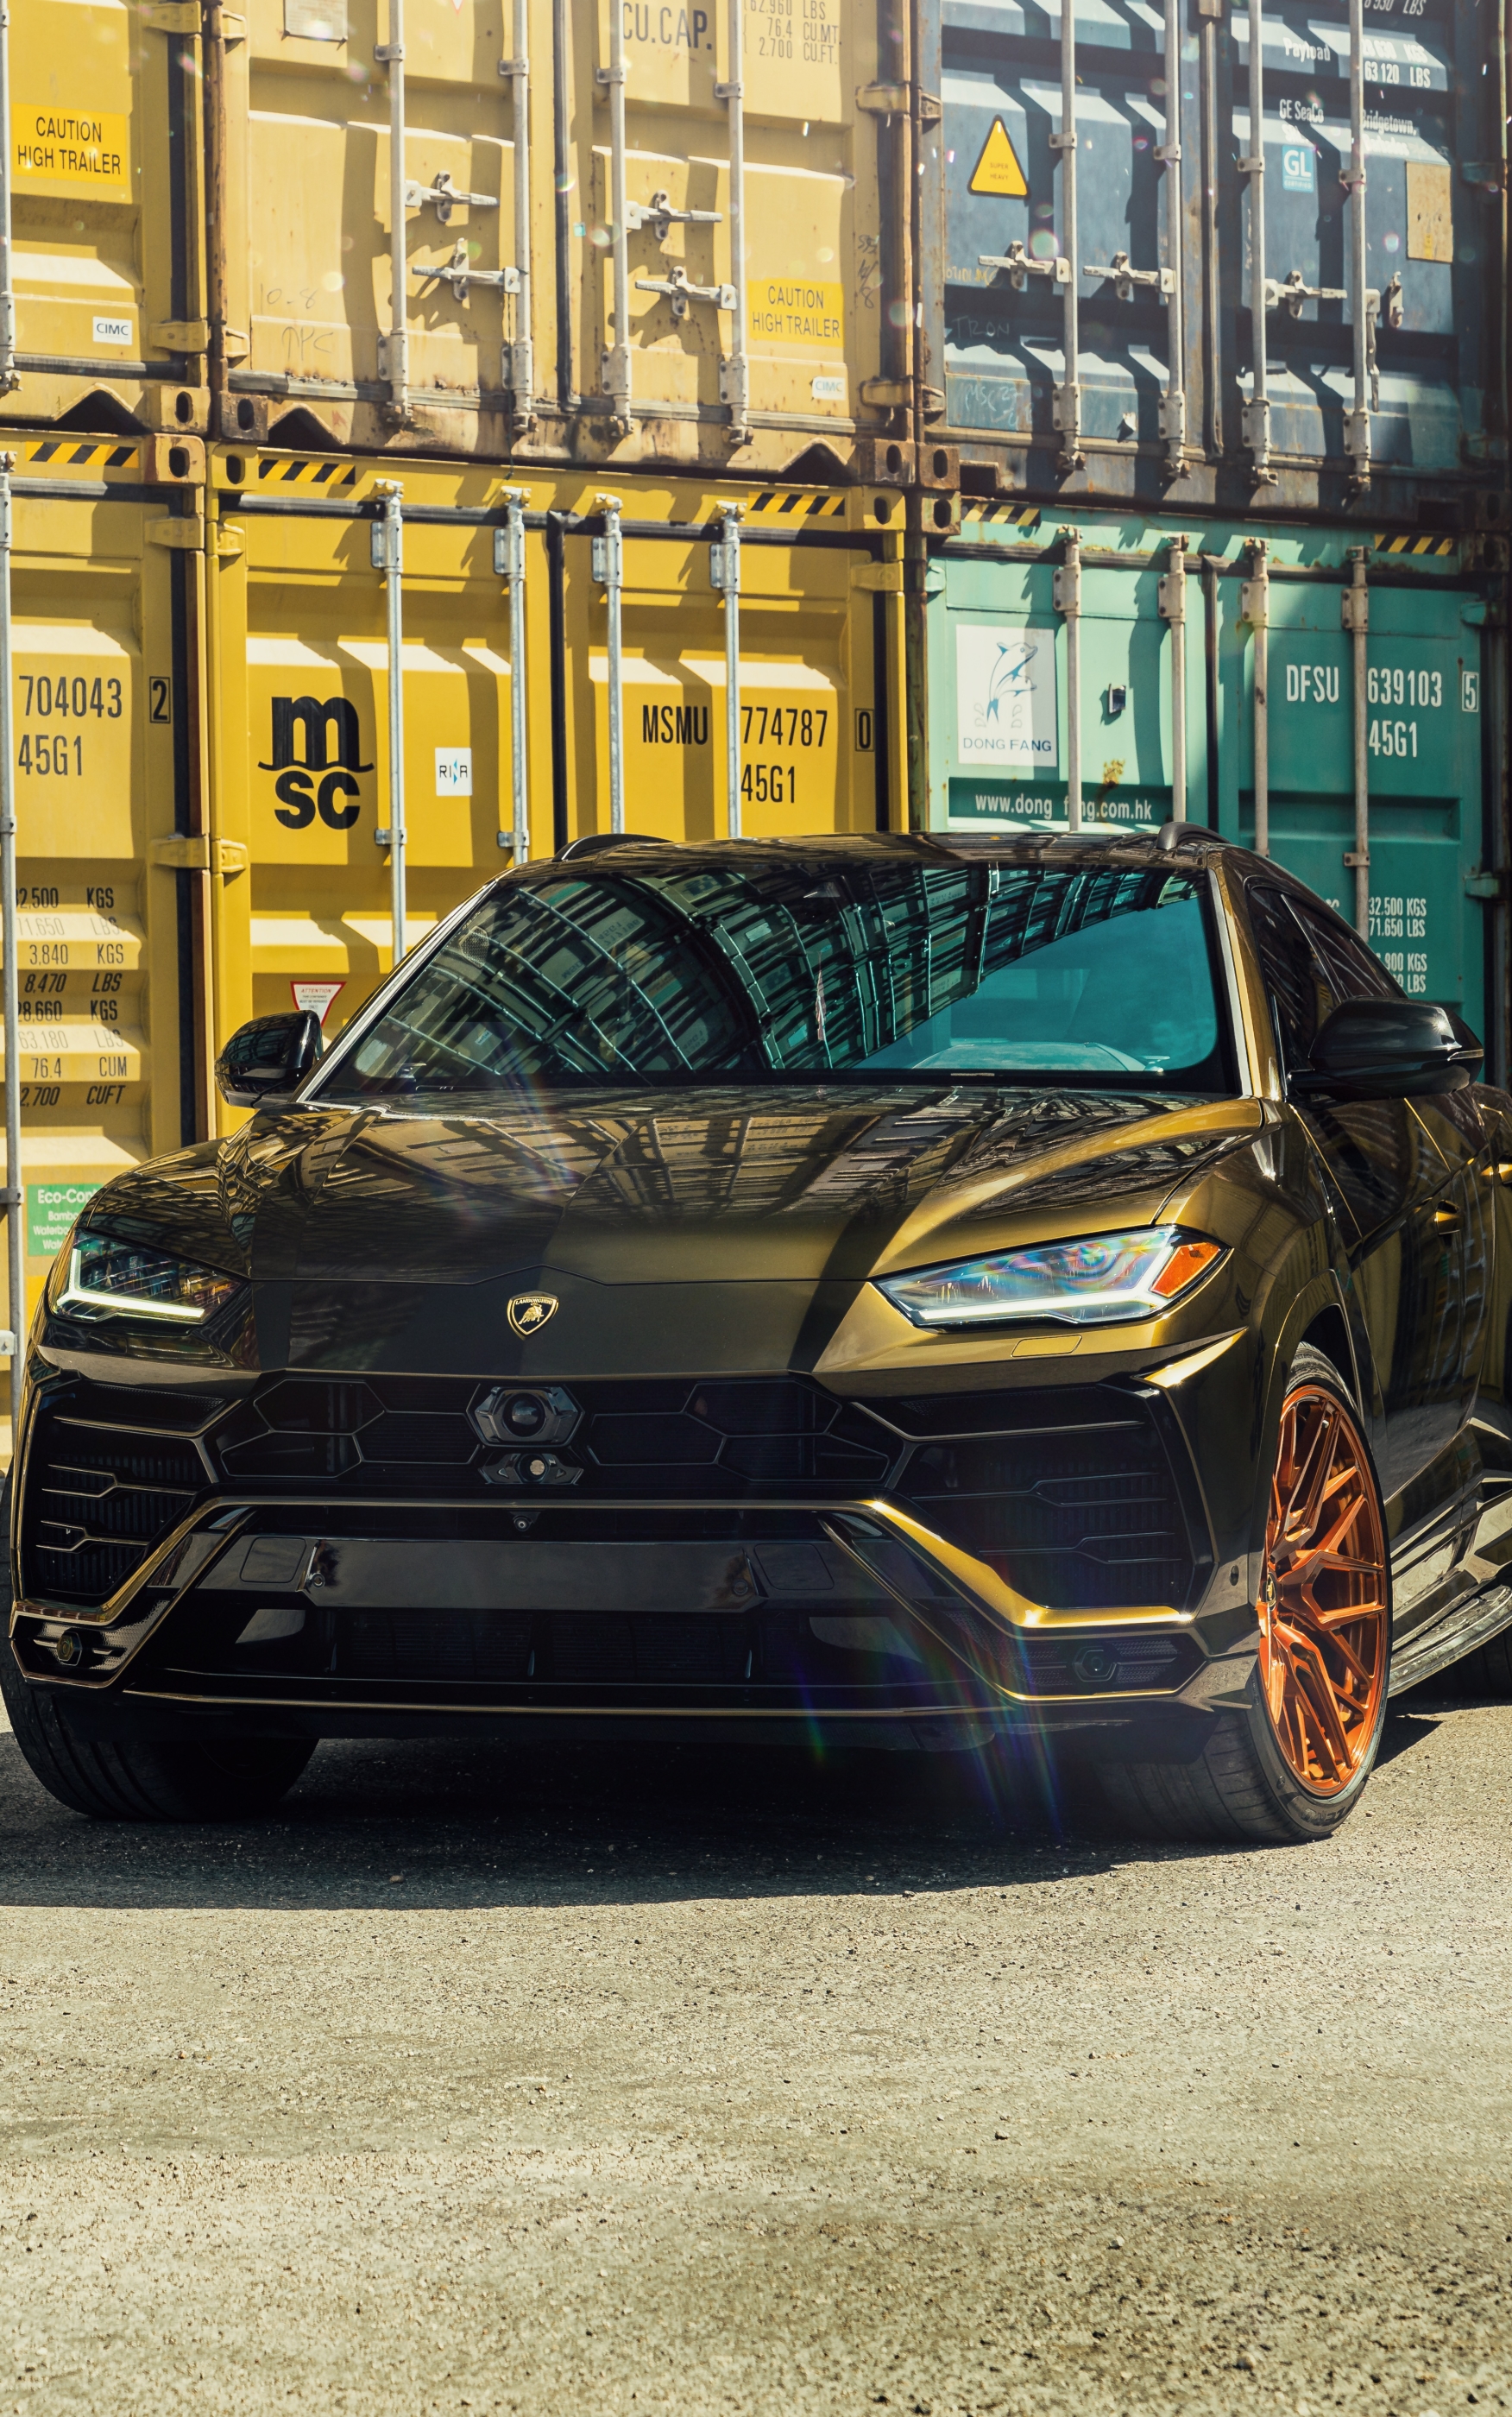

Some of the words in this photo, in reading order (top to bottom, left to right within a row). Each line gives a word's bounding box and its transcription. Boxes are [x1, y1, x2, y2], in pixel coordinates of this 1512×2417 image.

[803, 0, 826, 20] LBS
[1402, 0, 1427, 16] LBS
[622, 3, 712, 50] CU.CAP.
[767, 16, 792, 38] 76.4
[759, 36, 792, 59] 2.700
[1282, 37, 1331, 62] Payload
[1403, 43, 1428, 63] KGS
[1409, 66, 1430, 88] LBS
[1279, 99, 1293, 119] GE
[1295, 101, 1325, 123] SeaCo
[36, 117, 102, 142] CAUTION
[18, 144, 54, 168] HIGH
[59, 148, 121, 174] TRAILER
[990, 161, 1009, 170] SUPER
[1284, 149, 1312, 178] GL
[768, 286, 824, 309] CAUTION
[96, 323, 129, 337] CIMC
[753, 312, 783, 333] HIGH
[786, 315, 840, 338] TRAILER
[816, 380, 842, 393] CIMC
[19, 675, 122, 718] 704043
[152, 679, 168, 721] 2
[1286, 665, 1339, 703] DFSU
[1368, 667, 1442, 707] 639103
[1465, 675, 1476, 710] 5
[643, 705, 708, 745] MSMU
[741, 706, 828, 748] 774787
[963, 737, 1005, 750] DONG
[1010, 739, 1051, 752] FANG
[1369, 720, 1417, 758] 45G1
[18, 735, 82, 776] 45G1
[741, 764, 795, 803] 45G1
[1063, 795, 1152, 822] fng.com.hk
[87, 887, 114, 909] KGS
[1369, 897, 1403, 916] 32.500
[1407, 898, 1427, 917] KGS
[17, 917, 65, 936] 71,650
[89, 917, 120, 936] LBS
[1369, 918, 1403, 937] 71.650
[1407, 918, 1426, 937] LBS
[29, 943, 68, 965] 3,840
[98, 943, 124, 964] KGS
[1408, 953, 1427, 972] KGS
[24, 973, 67, 994] 8,470
[92, 973, 123, 993] LBS
[1408, 974, 1427, 993] LBS
[91, 1000, 117, 1021] KGS
[19, 1030, 68, 1050] 63,180
[95, 1029, 123, 1048] LBS
[33, 1057, 61, 1078] 76.4
[99, 1056, 127, 1077] CUM
[20, 1086, 60, 1108] 2,700
[86, 1085, 125, 1105] CUFT
[37, 1188, 98, 1204] Eco-Con
